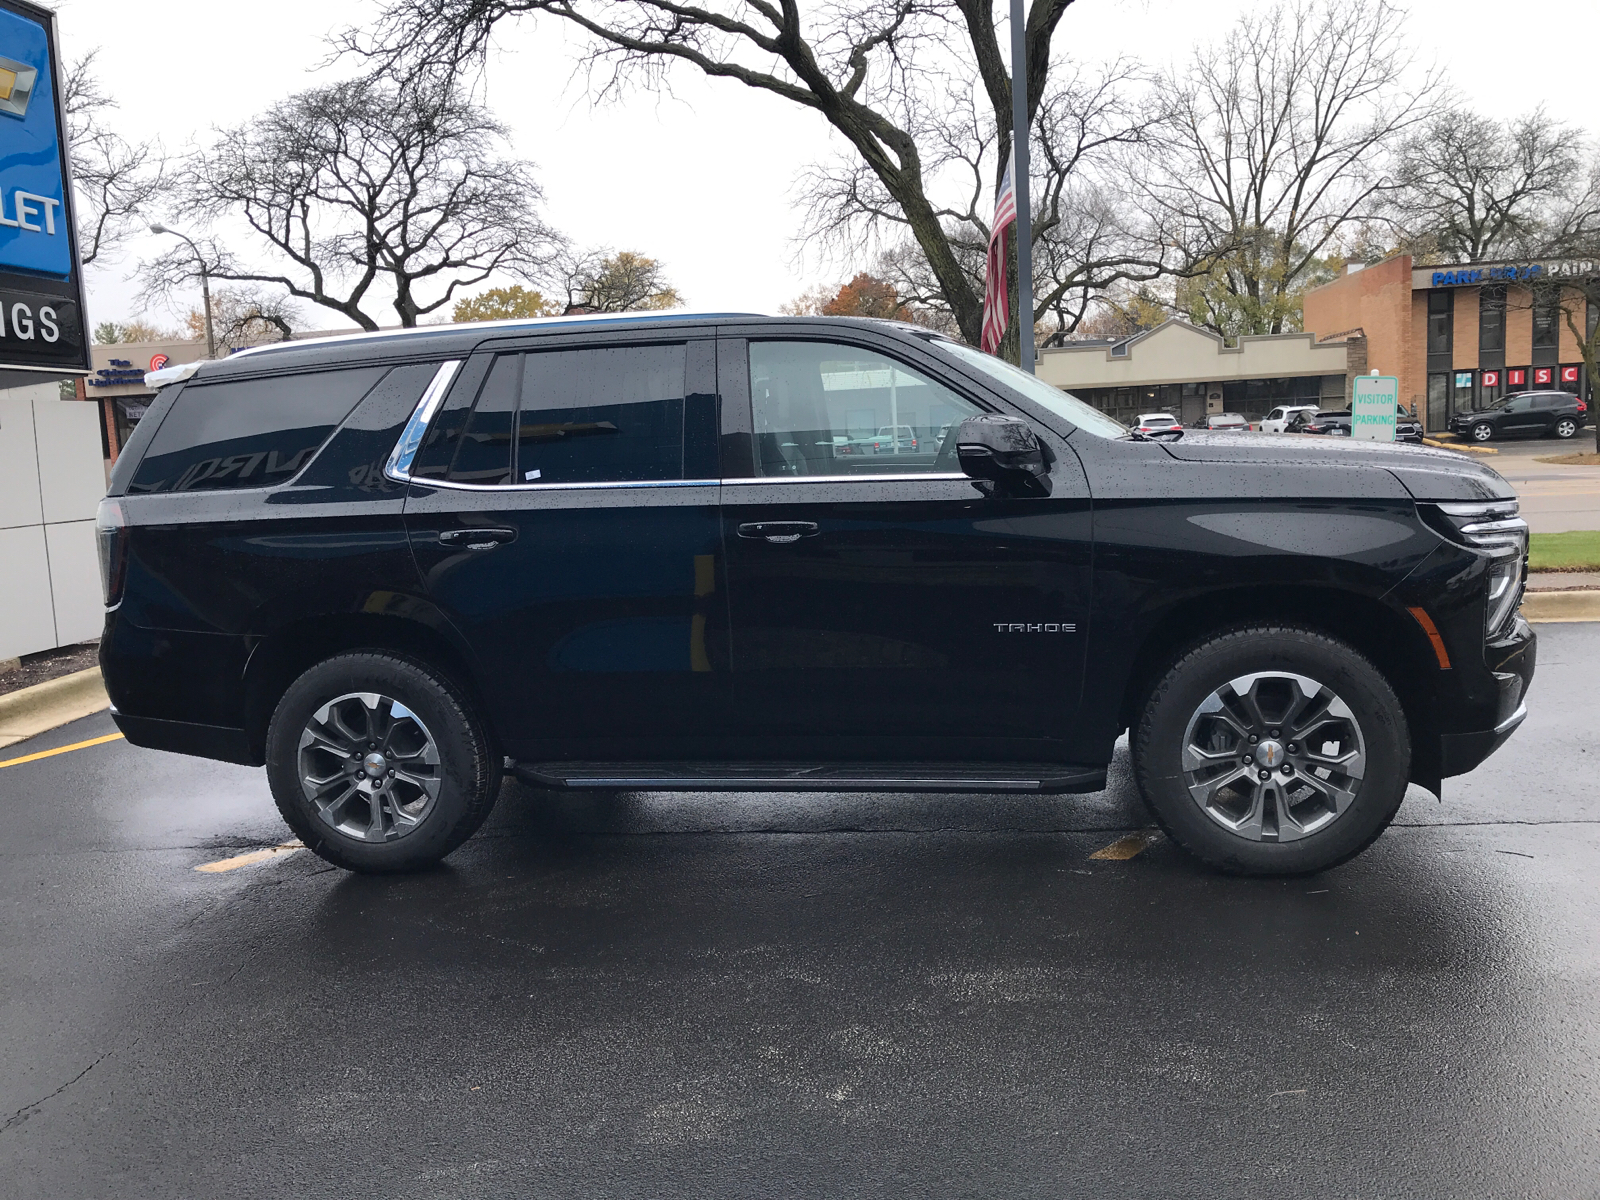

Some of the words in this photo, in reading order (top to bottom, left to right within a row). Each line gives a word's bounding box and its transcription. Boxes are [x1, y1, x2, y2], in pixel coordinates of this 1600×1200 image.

[1432, 269, 1483, 286] PARK
[0, 302, 60, 343] GS
[1357, 393, 1394, 405] VISITOR
[1355, 414, 1394, 425] PARKING
[993, 623, 1077, 633] TAHOE
